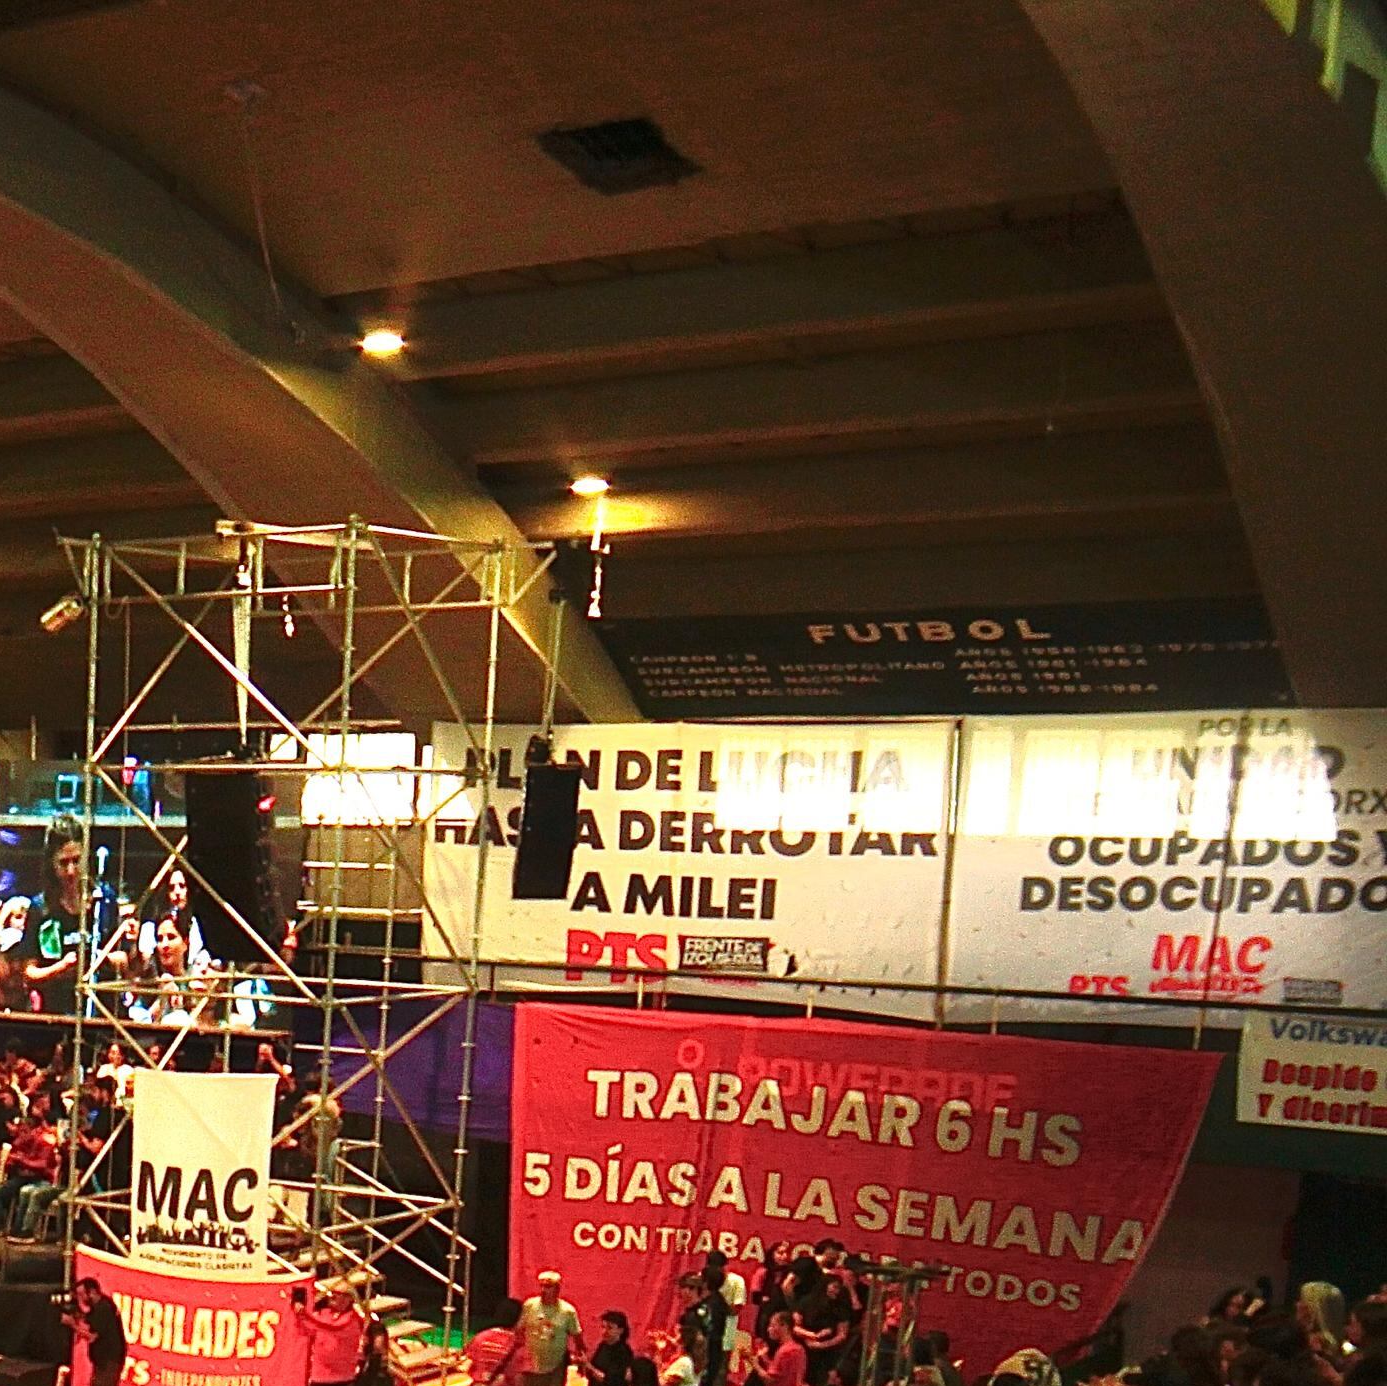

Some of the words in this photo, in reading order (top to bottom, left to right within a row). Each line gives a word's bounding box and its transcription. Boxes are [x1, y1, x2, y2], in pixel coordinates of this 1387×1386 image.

[807, 618, 1051, 644] FUTBOL
[465, 748, 601, 791] PLN
[615, 749, 683, 792] DE
[434, 805, 606, 851] HASA
[1047, 828, 1363, 868] OCUPADOS
[570, 871, 612, 914] A
[623, 873, 778, 921] MILEI
[565, 928, 668, 983] PTS
[684, 937, 745, 952] FRENTE
[1149, 933, 1273, 975] MAC
[1068, 974, 1130, 997] PTS
[1262, 1058, 1378, 1092] Despido
[586, 1068, 921, 1148] TRABAJAR
[935, 1099, 973, 1154] 6
[987, 1105, 1083, 1168] HS
[136, 1160, 259, 1224] MAC
[522, 1151, 552, 1199] 5
[563, 1142, 698, 1207] DÍAS
[705, 1165, 750, 1214] A
[763, 1171, 841, 1227] LA
[853, 1183, 1147, 1266] SEMANA
[572, 1219, 648, 1254] CON
[943, 1264, 1083, 1313] TODOS
[120, 1355, 151, 1386] TS
